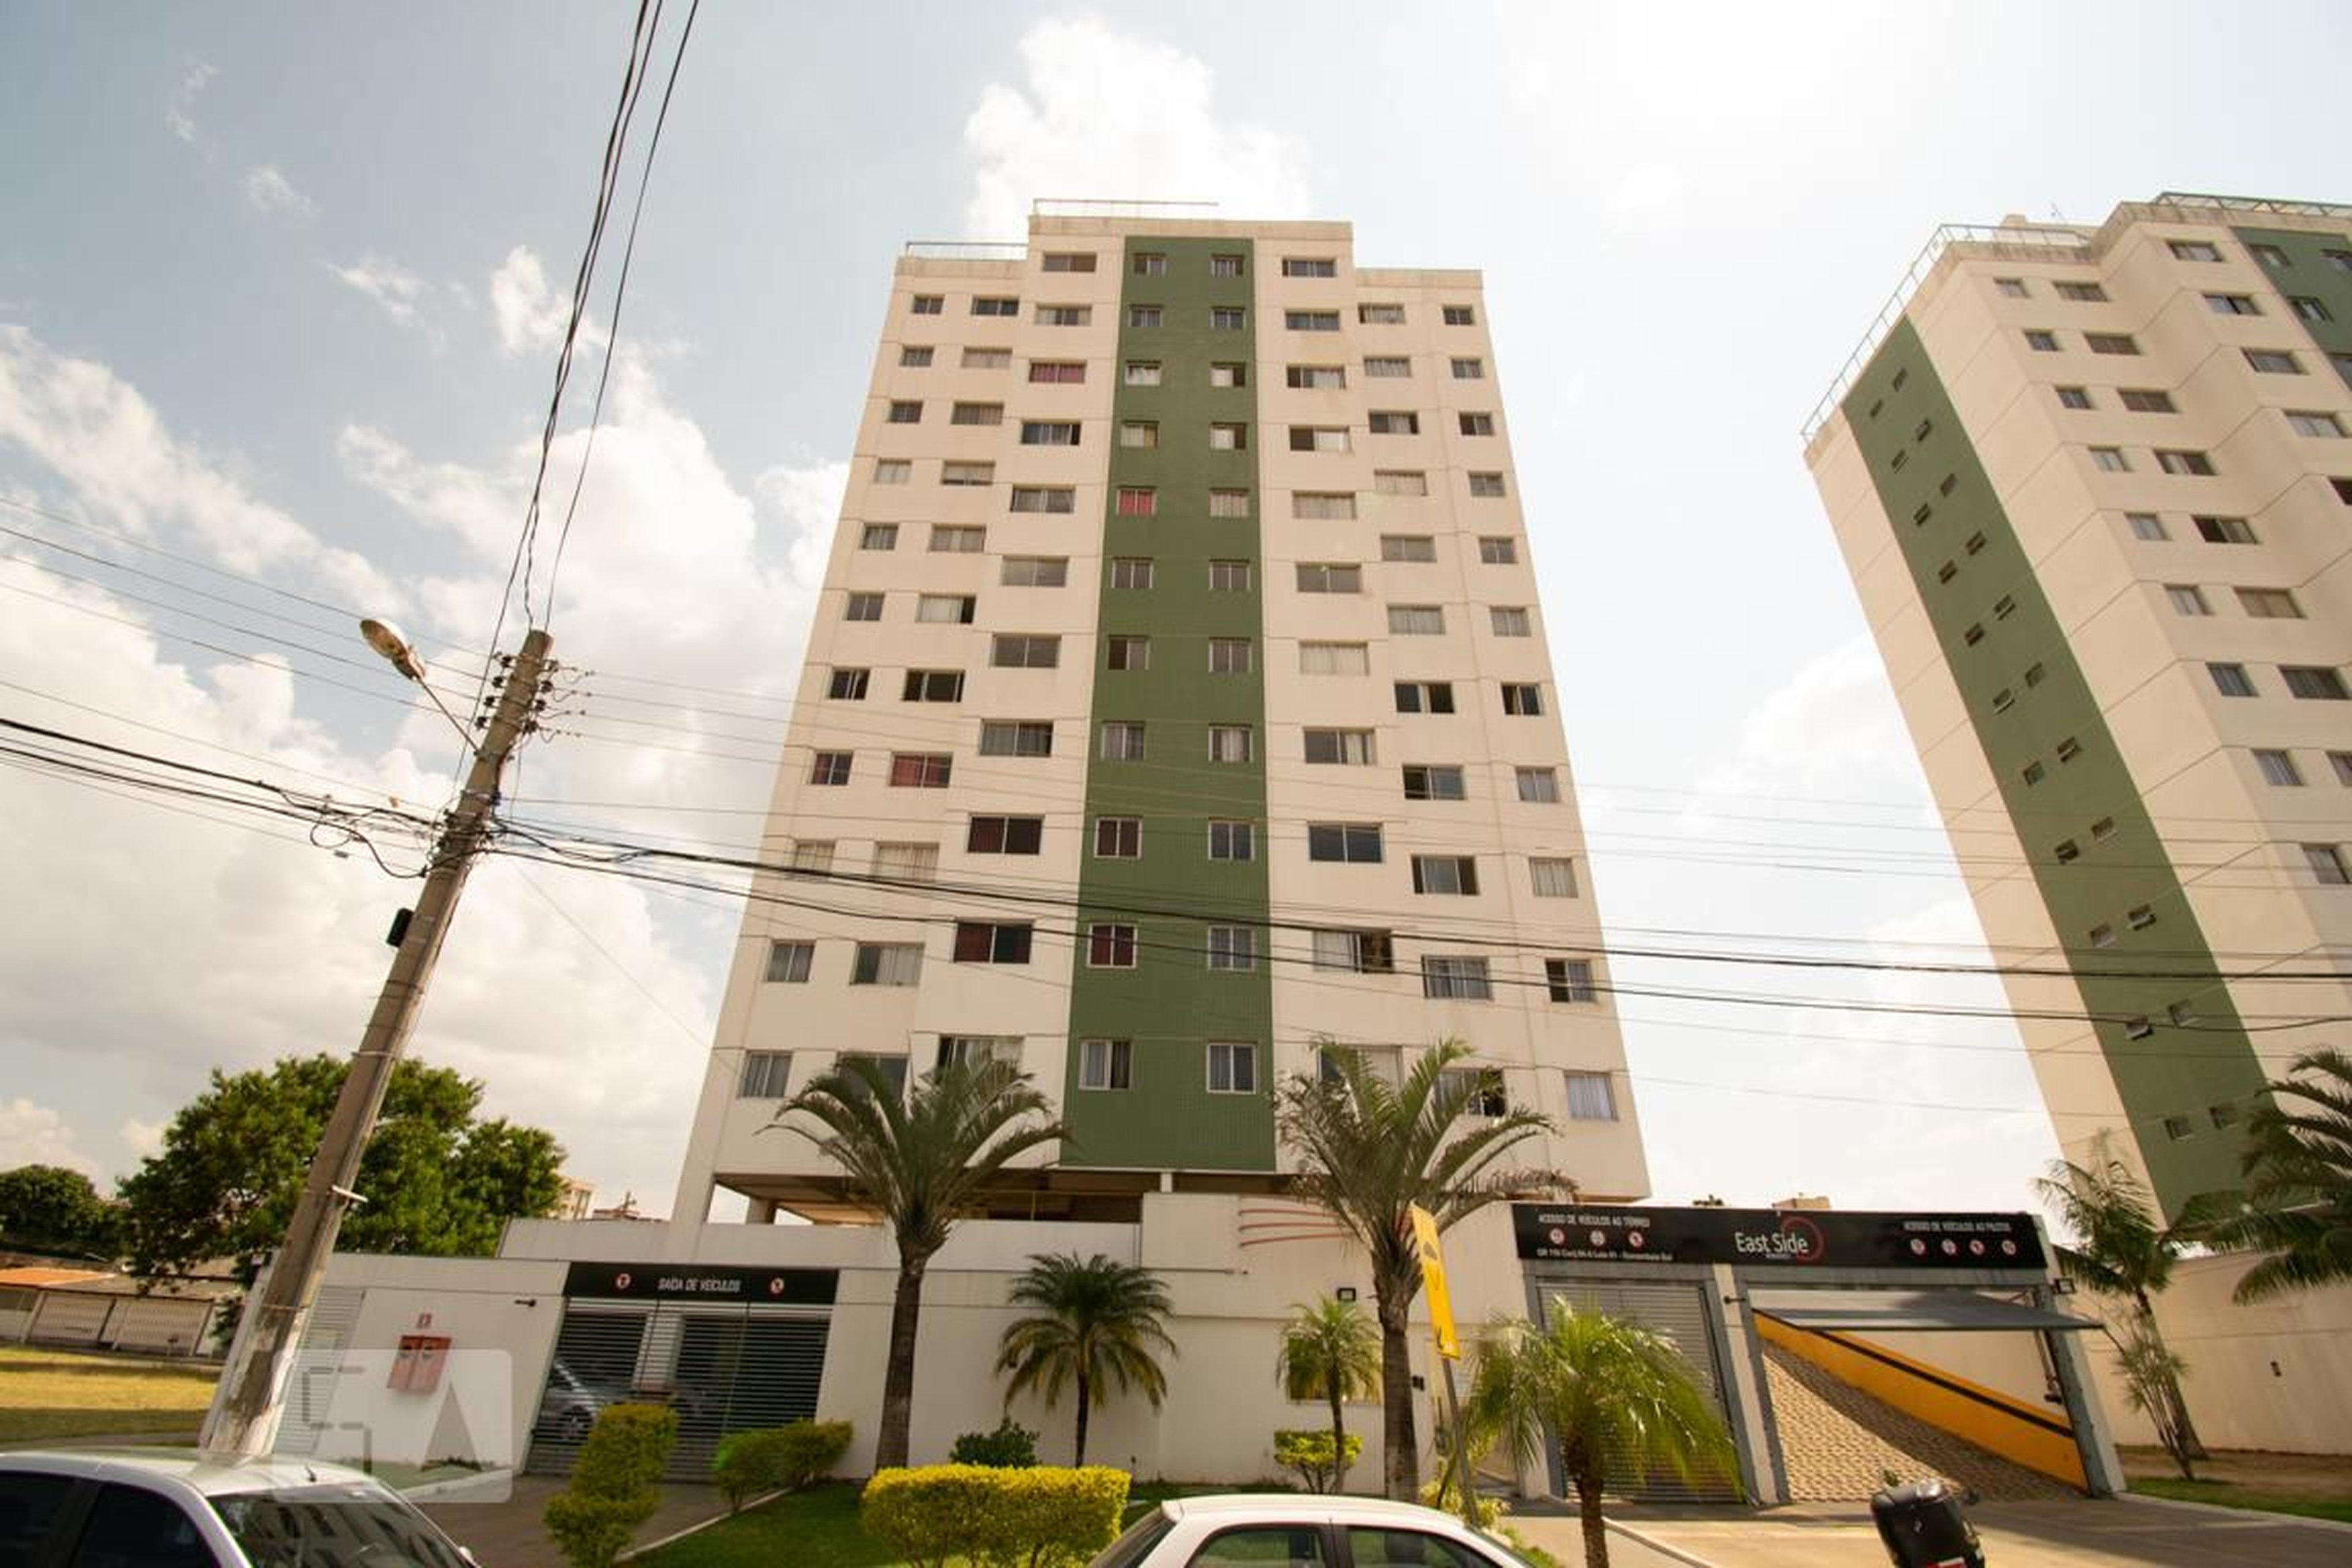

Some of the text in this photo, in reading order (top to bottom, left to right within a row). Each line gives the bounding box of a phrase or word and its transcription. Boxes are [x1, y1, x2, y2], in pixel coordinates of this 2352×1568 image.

[1734, 1231, 1809, 1254] East Side
[685, 1278, 698, 1292] DE
